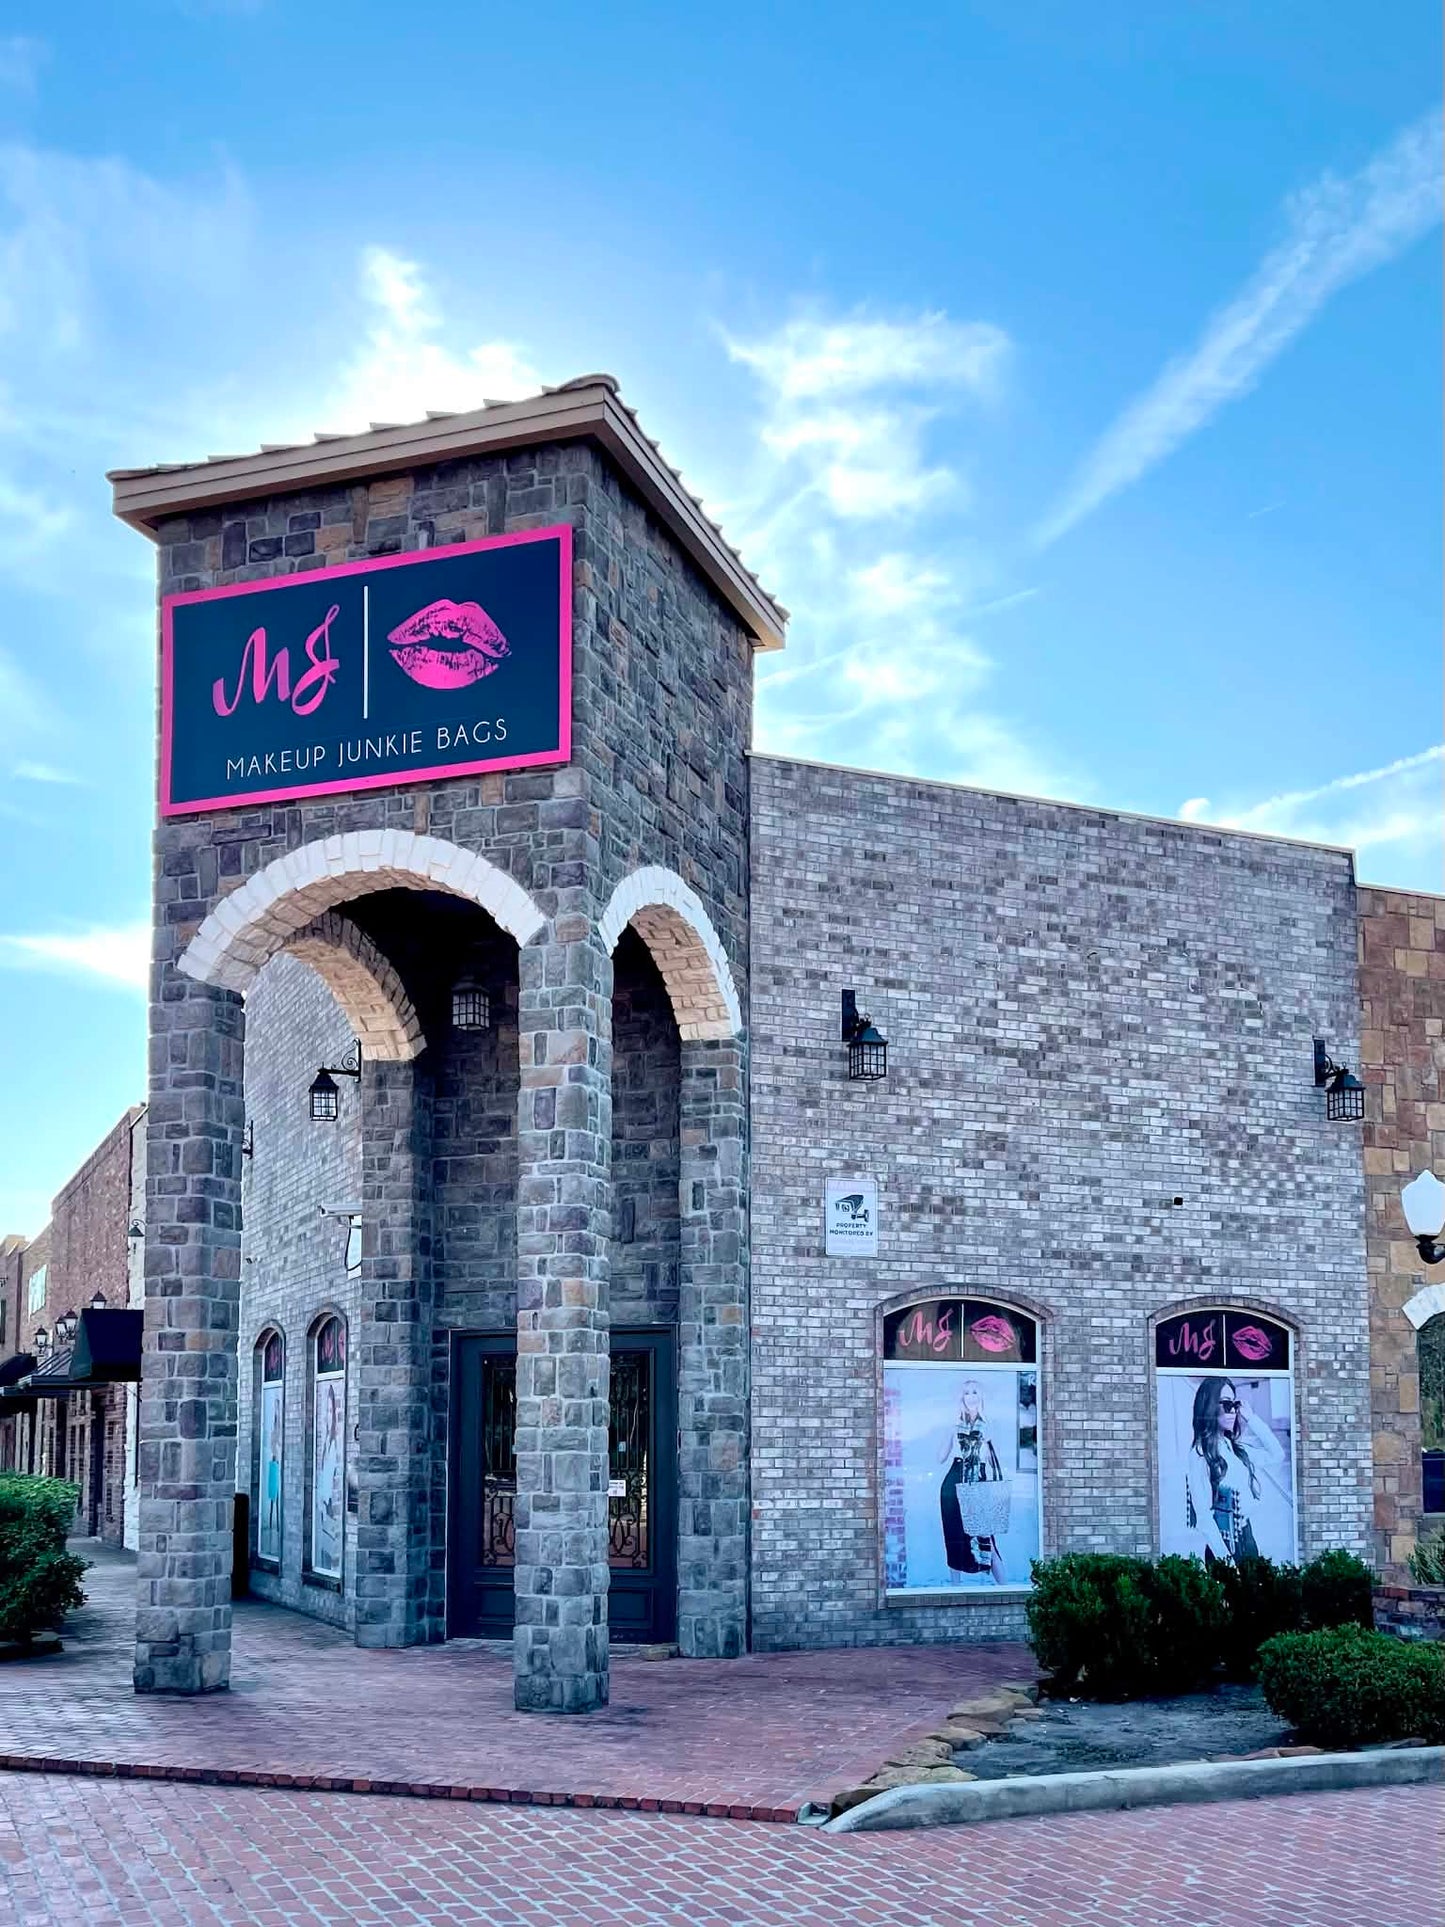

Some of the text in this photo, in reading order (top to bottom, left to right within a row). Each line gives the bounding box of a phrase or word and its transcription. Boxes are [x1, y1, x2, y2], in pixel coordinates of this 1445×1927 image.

[227, 718, 507, 780] MAKEUP JUNKIE BAGS
